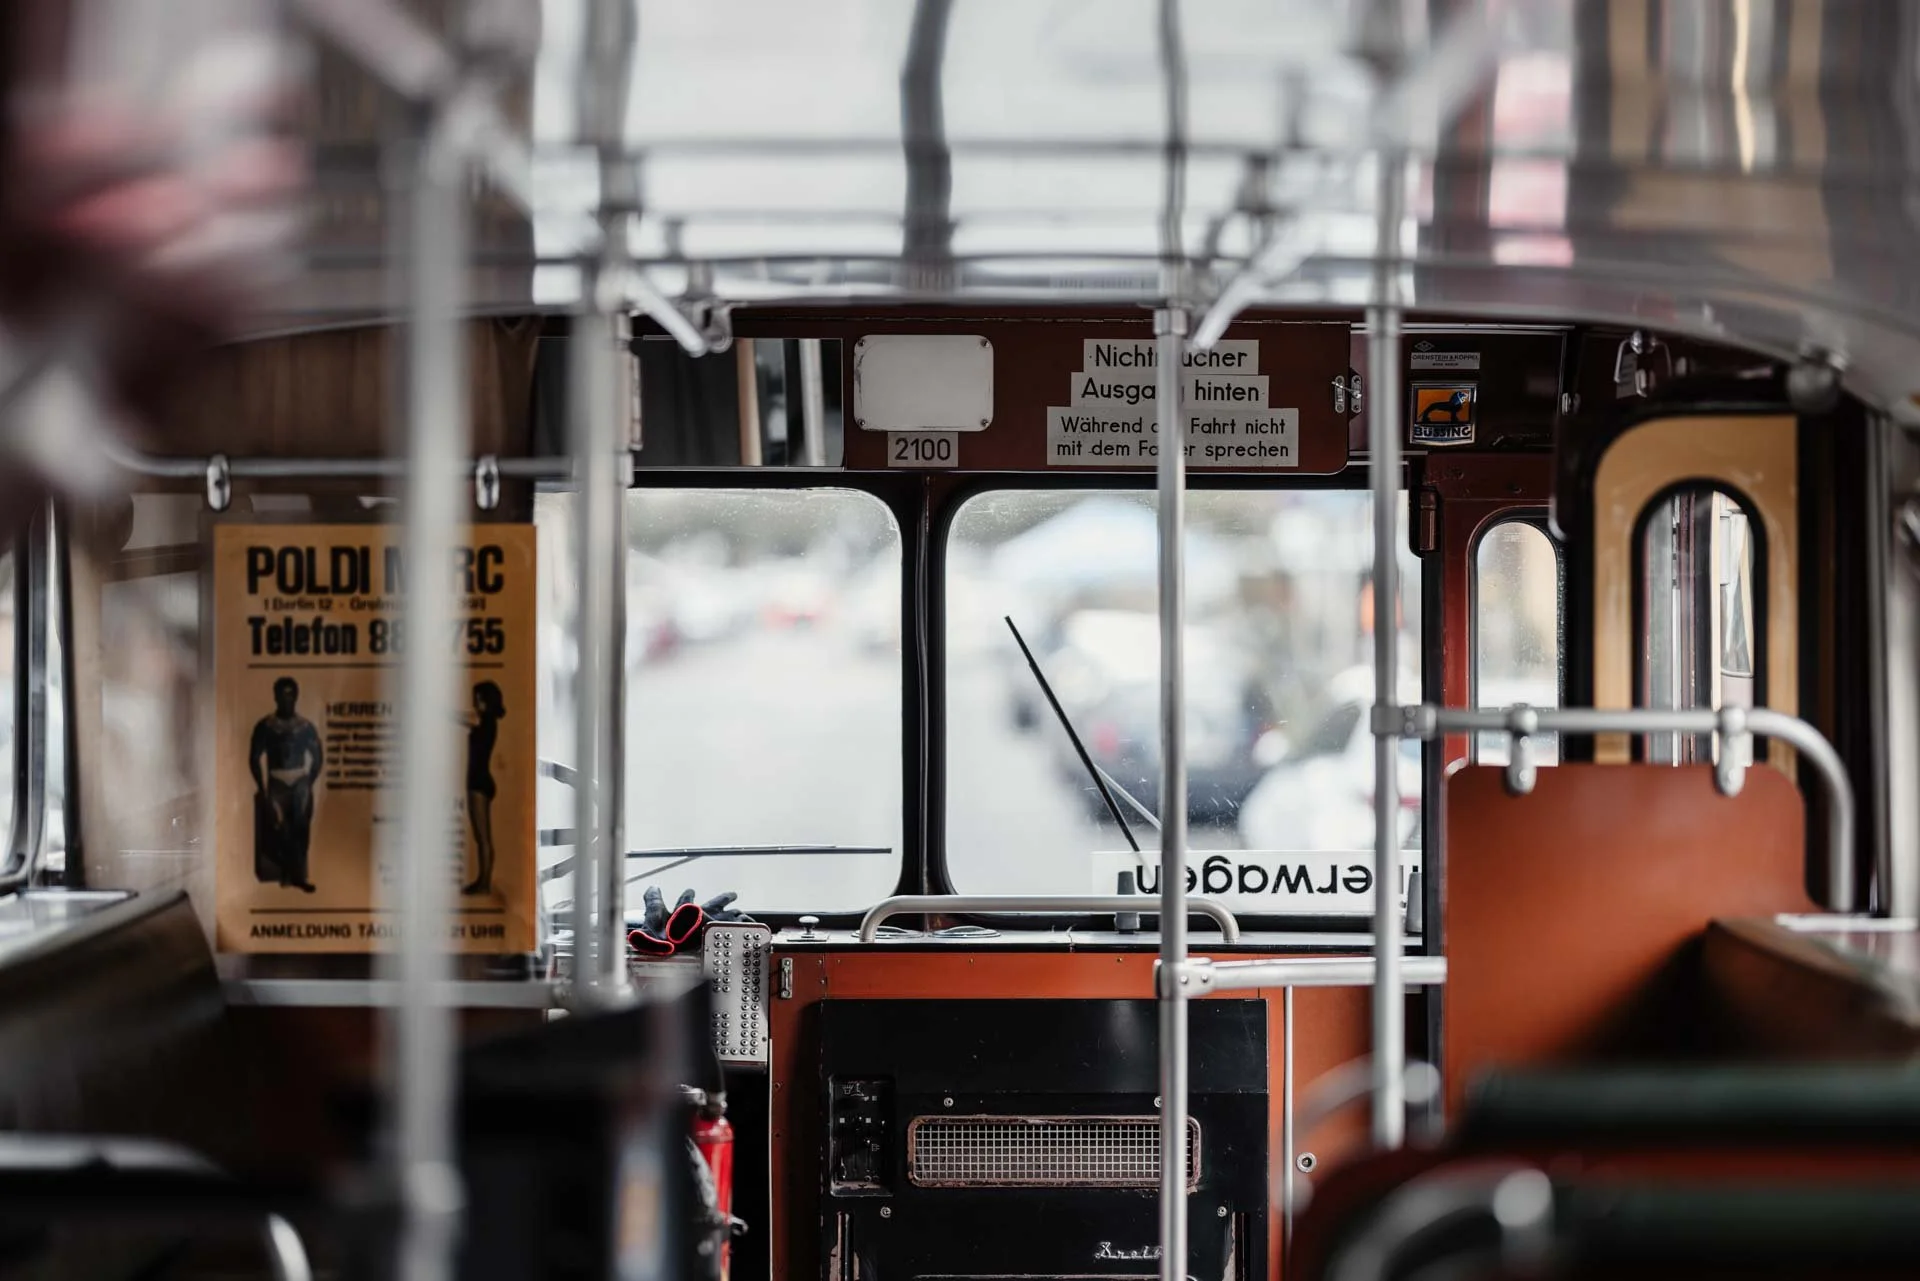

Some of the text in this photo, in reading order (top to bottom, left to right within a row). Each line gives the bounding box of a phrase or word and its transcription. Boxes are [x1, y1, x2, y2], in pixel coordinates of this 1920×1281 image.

[1095, 344, 1247, 368] Nichtucher
[1081, 377, 1260, 405] Ausga hinten
[1061, 416, 1142, 433] Während
[1191, 418, 1236, 434] Fahrt
[1245, 418, 1285, 434] nicht
[1414, 425, 1471, 437] BÜSSING
[895, 437, 951, 460] 2100
[1057, 440, 1289, 461] mit dem Faer sprechen
[247, 545, 504, 595] POLDI MRC
[248, 616, 358, 655] Telefon
[326, 702, 392, 717] HERREN
[251, 924, 351, 939] ANMELDUNG
[471, 924, 505, 938] UHR
